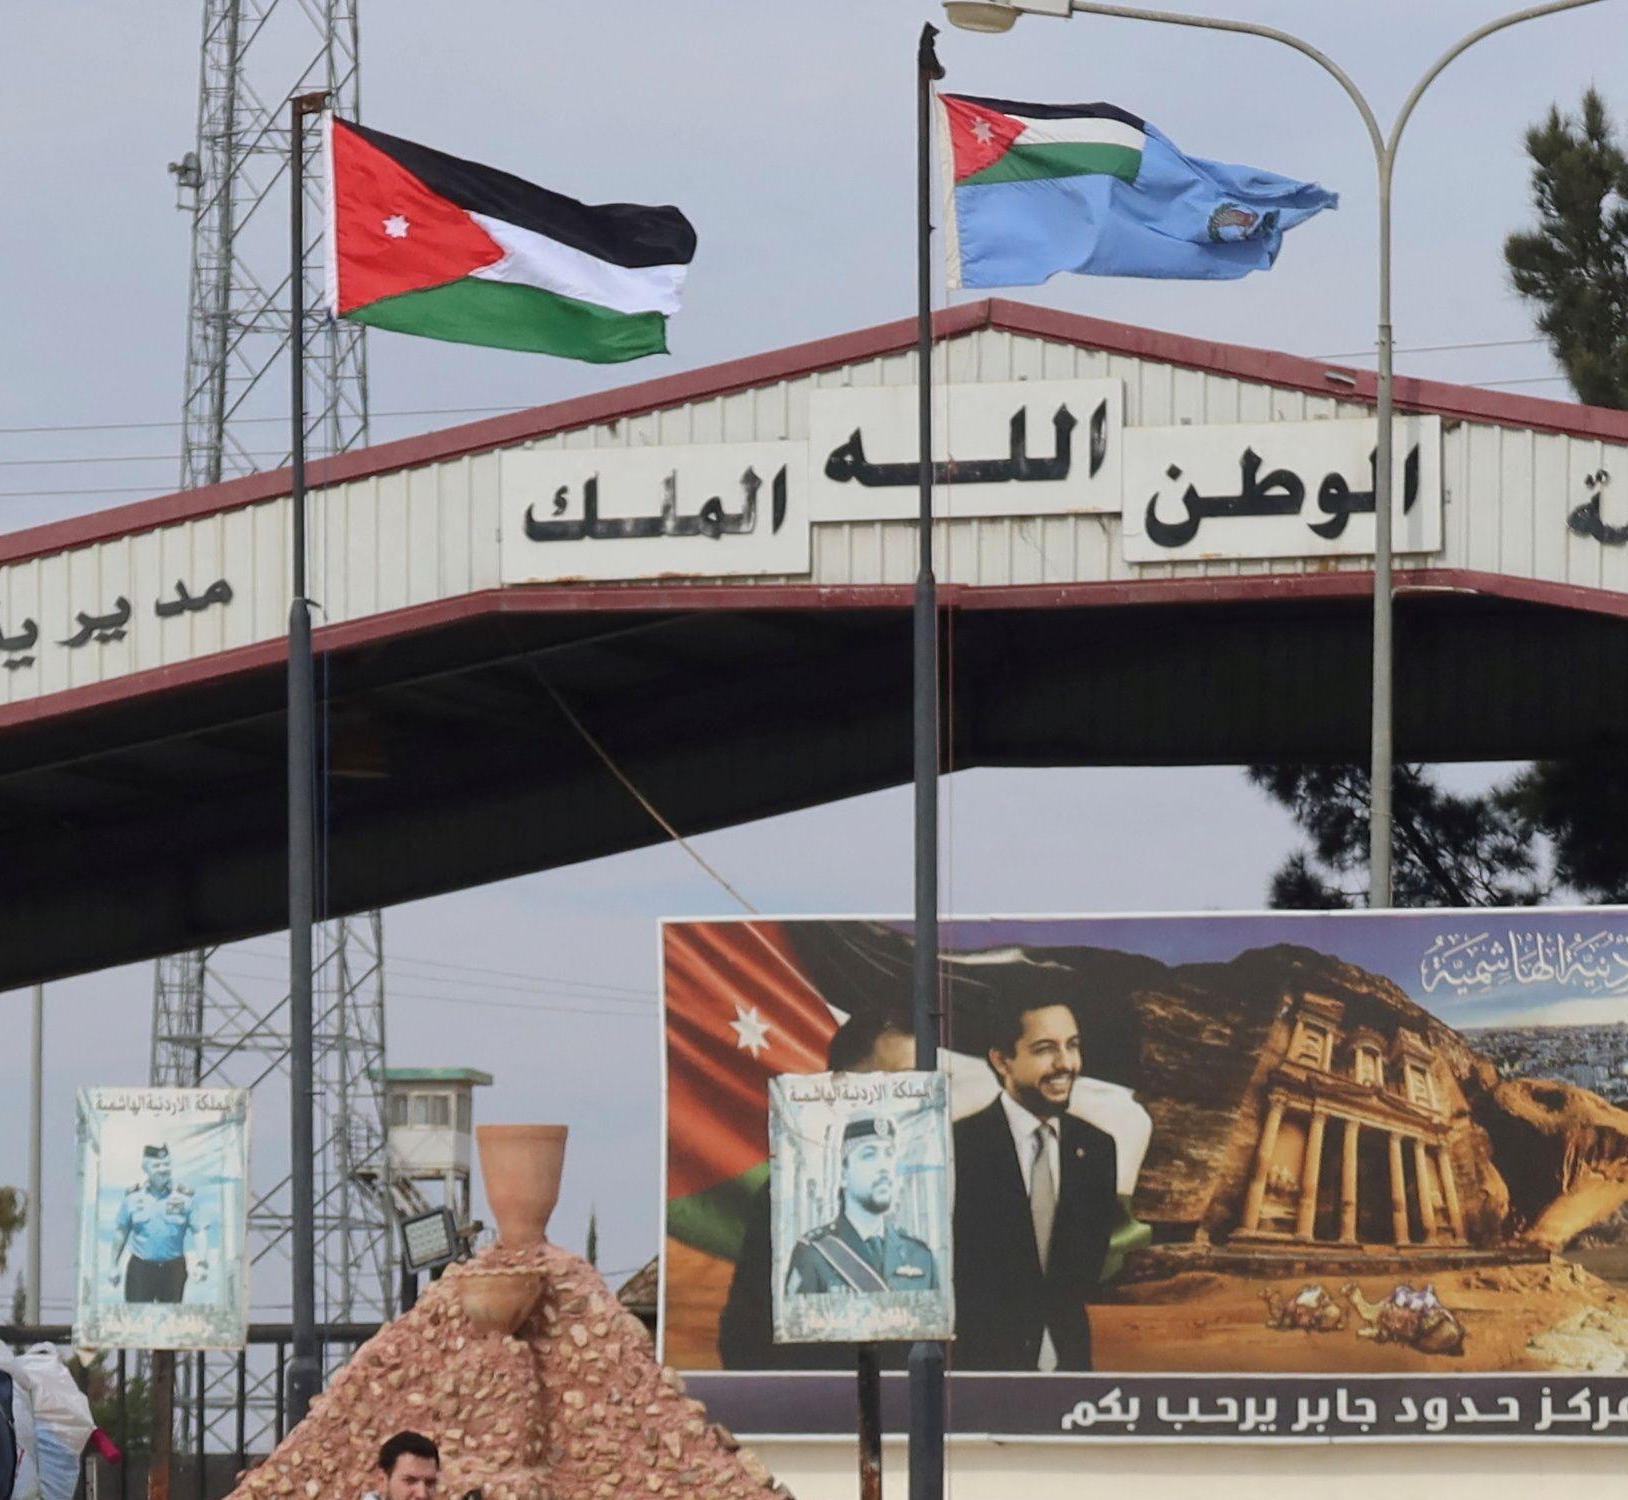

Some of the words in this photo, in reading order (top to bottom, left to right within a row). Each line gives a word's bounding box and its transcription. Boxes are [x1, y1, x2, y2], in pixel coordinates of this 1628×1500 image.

[824, 398, 1108, 488] الله
[524, 464, 788, 544] الملك
[1061, 1388, 1141, 1431] بكم
[1156, 1395, 1277, 1432] يرحب
[1291, 1388, 1377, 1433] جابر
[1395, 1395, 1520, 1431] حدود
